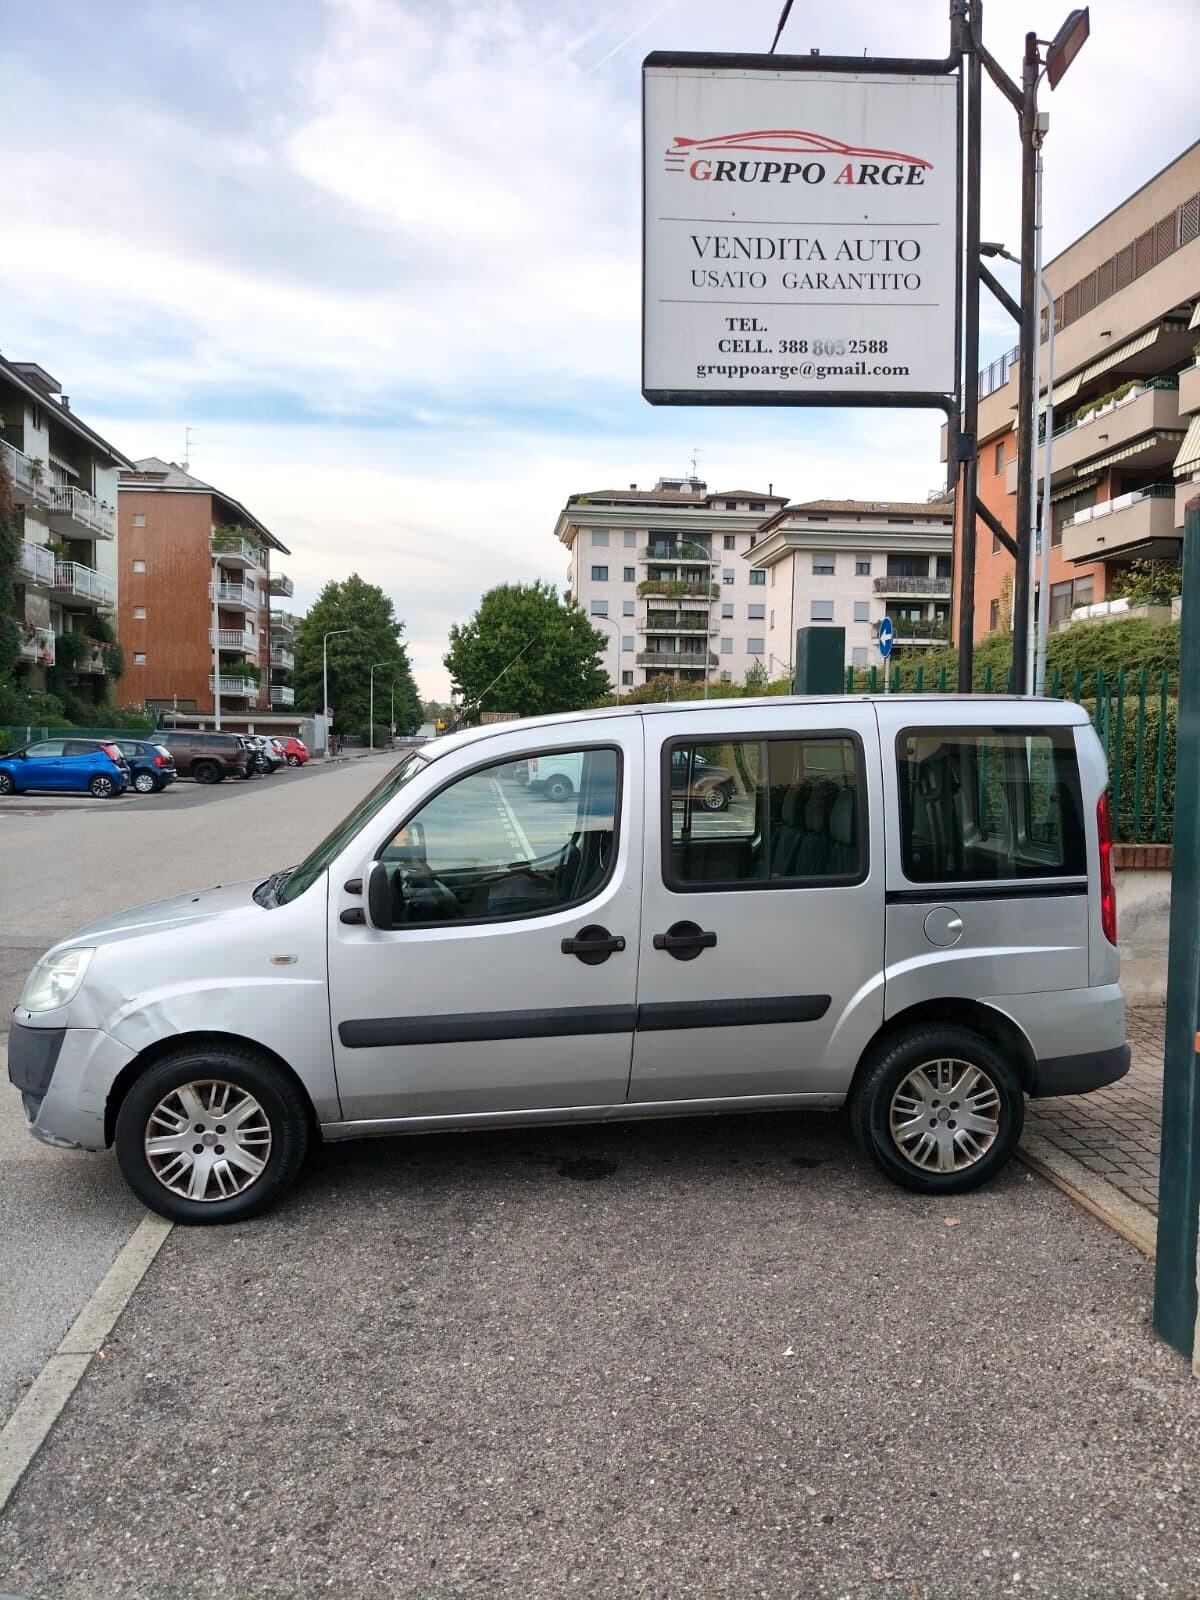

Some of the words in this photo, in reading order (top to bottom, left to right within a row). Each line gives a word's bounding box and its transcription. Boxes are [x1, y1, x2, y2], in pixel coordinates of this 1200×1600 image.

[690, 159, 826, 185] GRUPPO
[833, 163, 926, 185] ARGE
[690, 235, 828, 261] VENDITA
[835, 239, 921, 262] AUTO
[690, 270, 767, 289] USATO
[782, 272, 922, 290] GARANTITO
[725, 317, 768, 332] TEL.
[718, 339, 773, 354] CELL.
[778, 340, 808, 354] 388
[848, 341, 888, 354] 2588
[697, 361, 910, 380] gruppoarge@gmail.com
